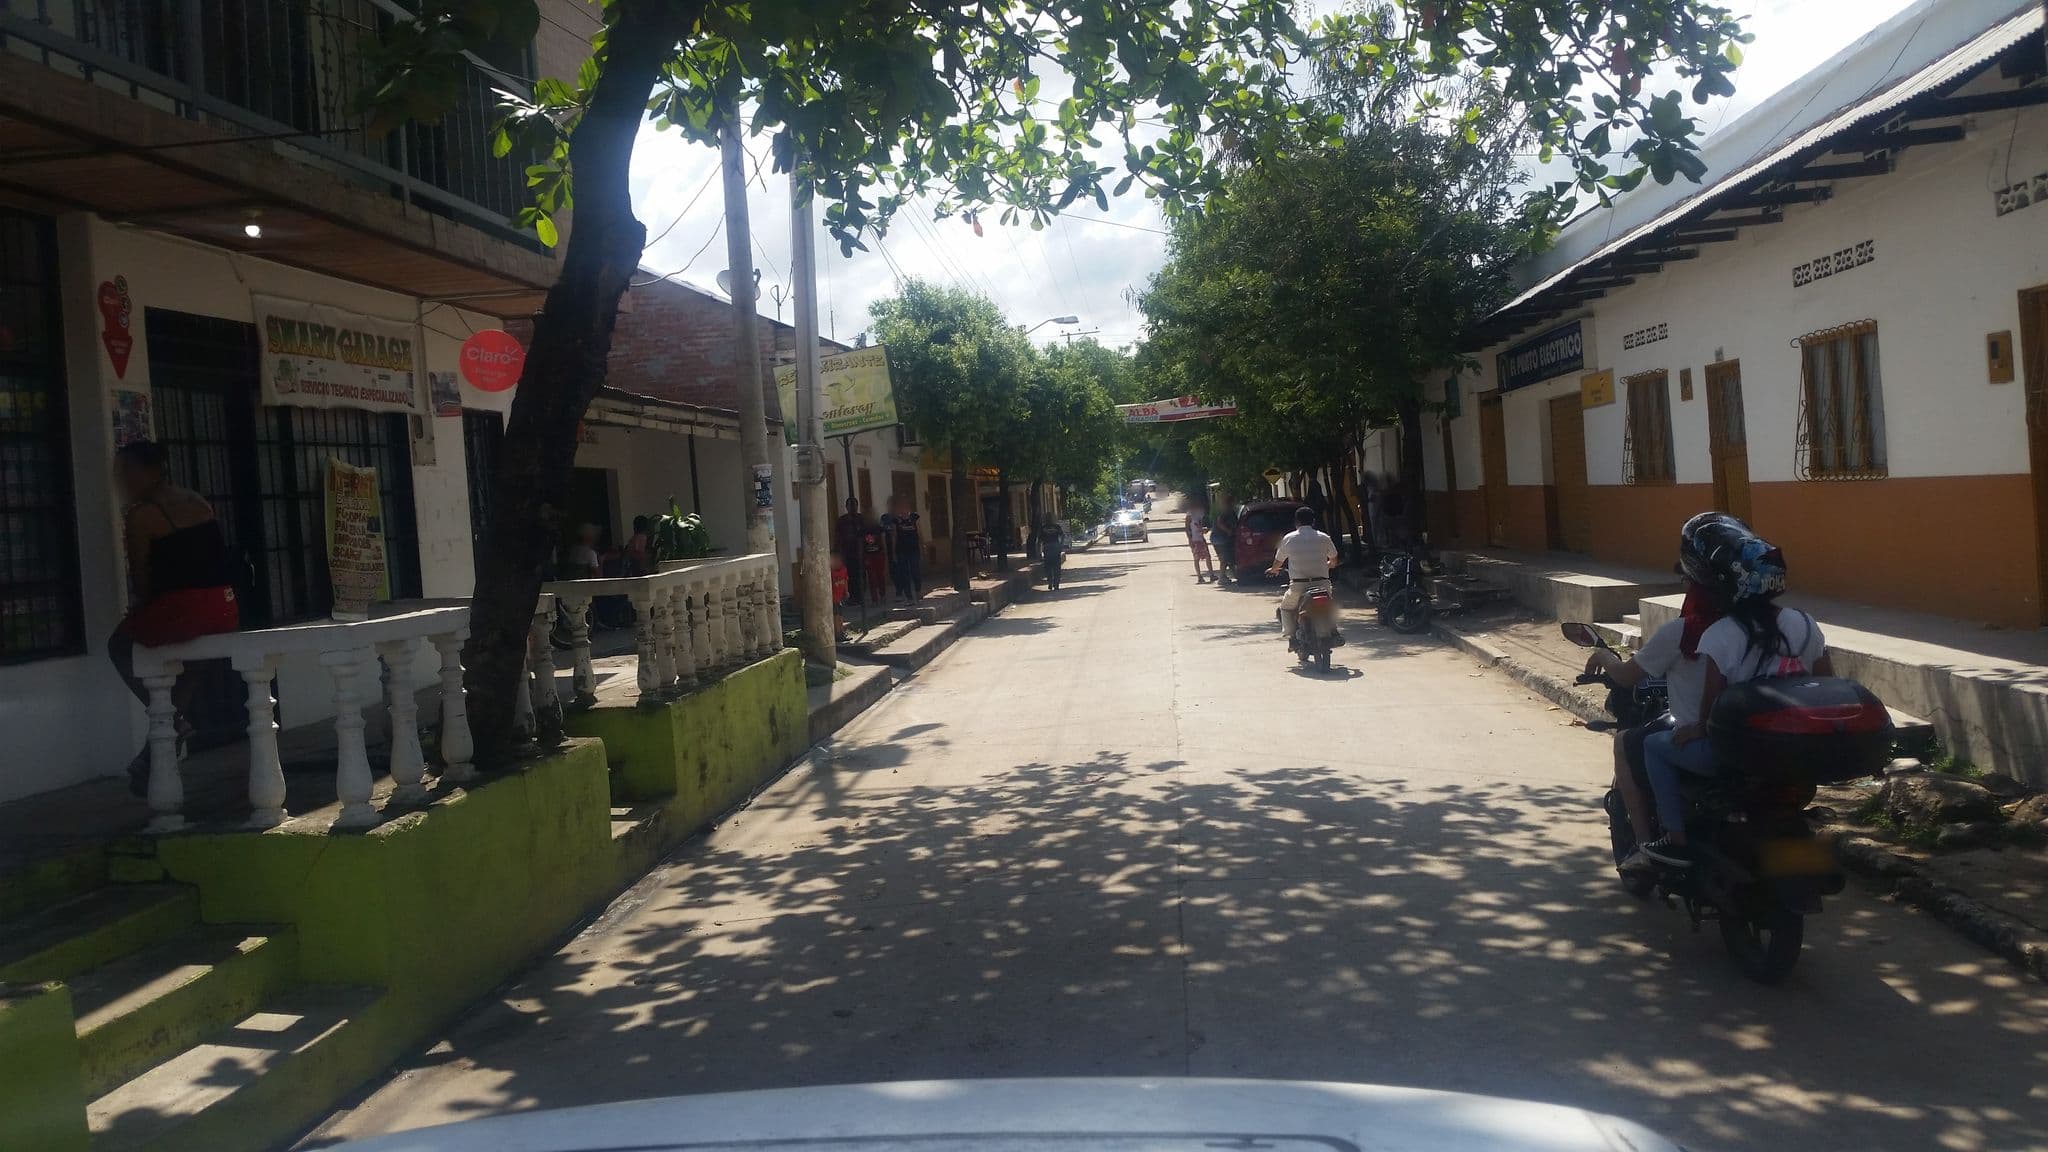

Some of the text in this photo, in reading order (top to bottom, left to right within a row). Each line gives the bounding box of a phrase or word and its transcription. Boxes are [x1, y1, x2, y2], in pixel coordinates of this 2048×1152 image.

[266, 314, 414, 372] SMART GARAGE
[466, 346, 512, 365] Claro
[301, 379, 409, 404] SERVICIO TECNICO ESPECIALIZADO
[1128, 407, 1159, 417] ALBA
